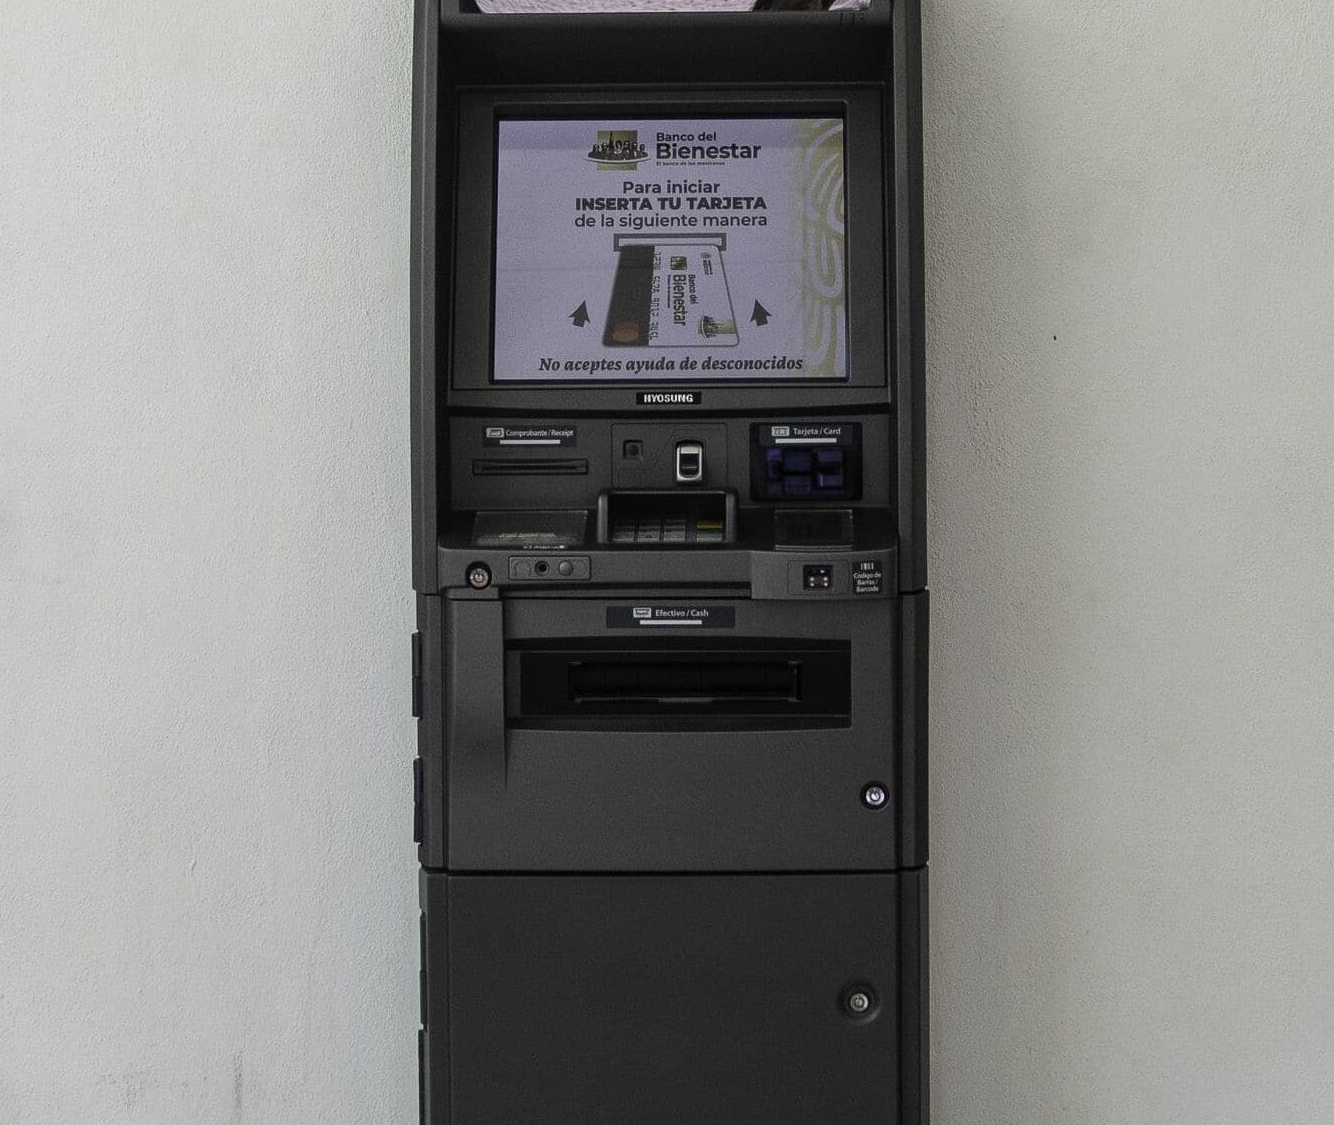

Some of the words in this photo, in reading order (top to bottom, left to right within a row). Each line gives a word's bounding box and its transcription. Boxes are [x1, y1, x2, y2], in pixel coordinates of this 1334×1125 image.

[656, 132, 695, 142] Banco
[698, 131, 717, 142] del
[656, 142, 761, 160] Bienestar
[623, 181, 661, 194] Para
[667, 179, 720, 194] iniciar
[575, 198, 653, 211] INSERTA
[657, 198, 681, 211] TU
[686, 197, 767, 211] TARJETA
[575, 214, 596, 228] de
[601, 214, 614, 227] la
[619, 213, 699, 230] siguiente
[703, 216, 768, 227] manera
[672, 274, 687, 326] Bienestar
[538, 358, 560, 371] No
[564, 358, 621, 374] aceptes
[625, 356, 675, 373] ayuda
[680, 356, 697, 370] de
[701, 355, 803, 370] desconocidos
[643, 393, 694, 403] HYOSUNG
[793, 427, 818, 436] Tarjeta
[823, 427, 841, 435] Card
[655, 609, 685, 617] Efectivo
[690, 609, 709, 617] Cash
